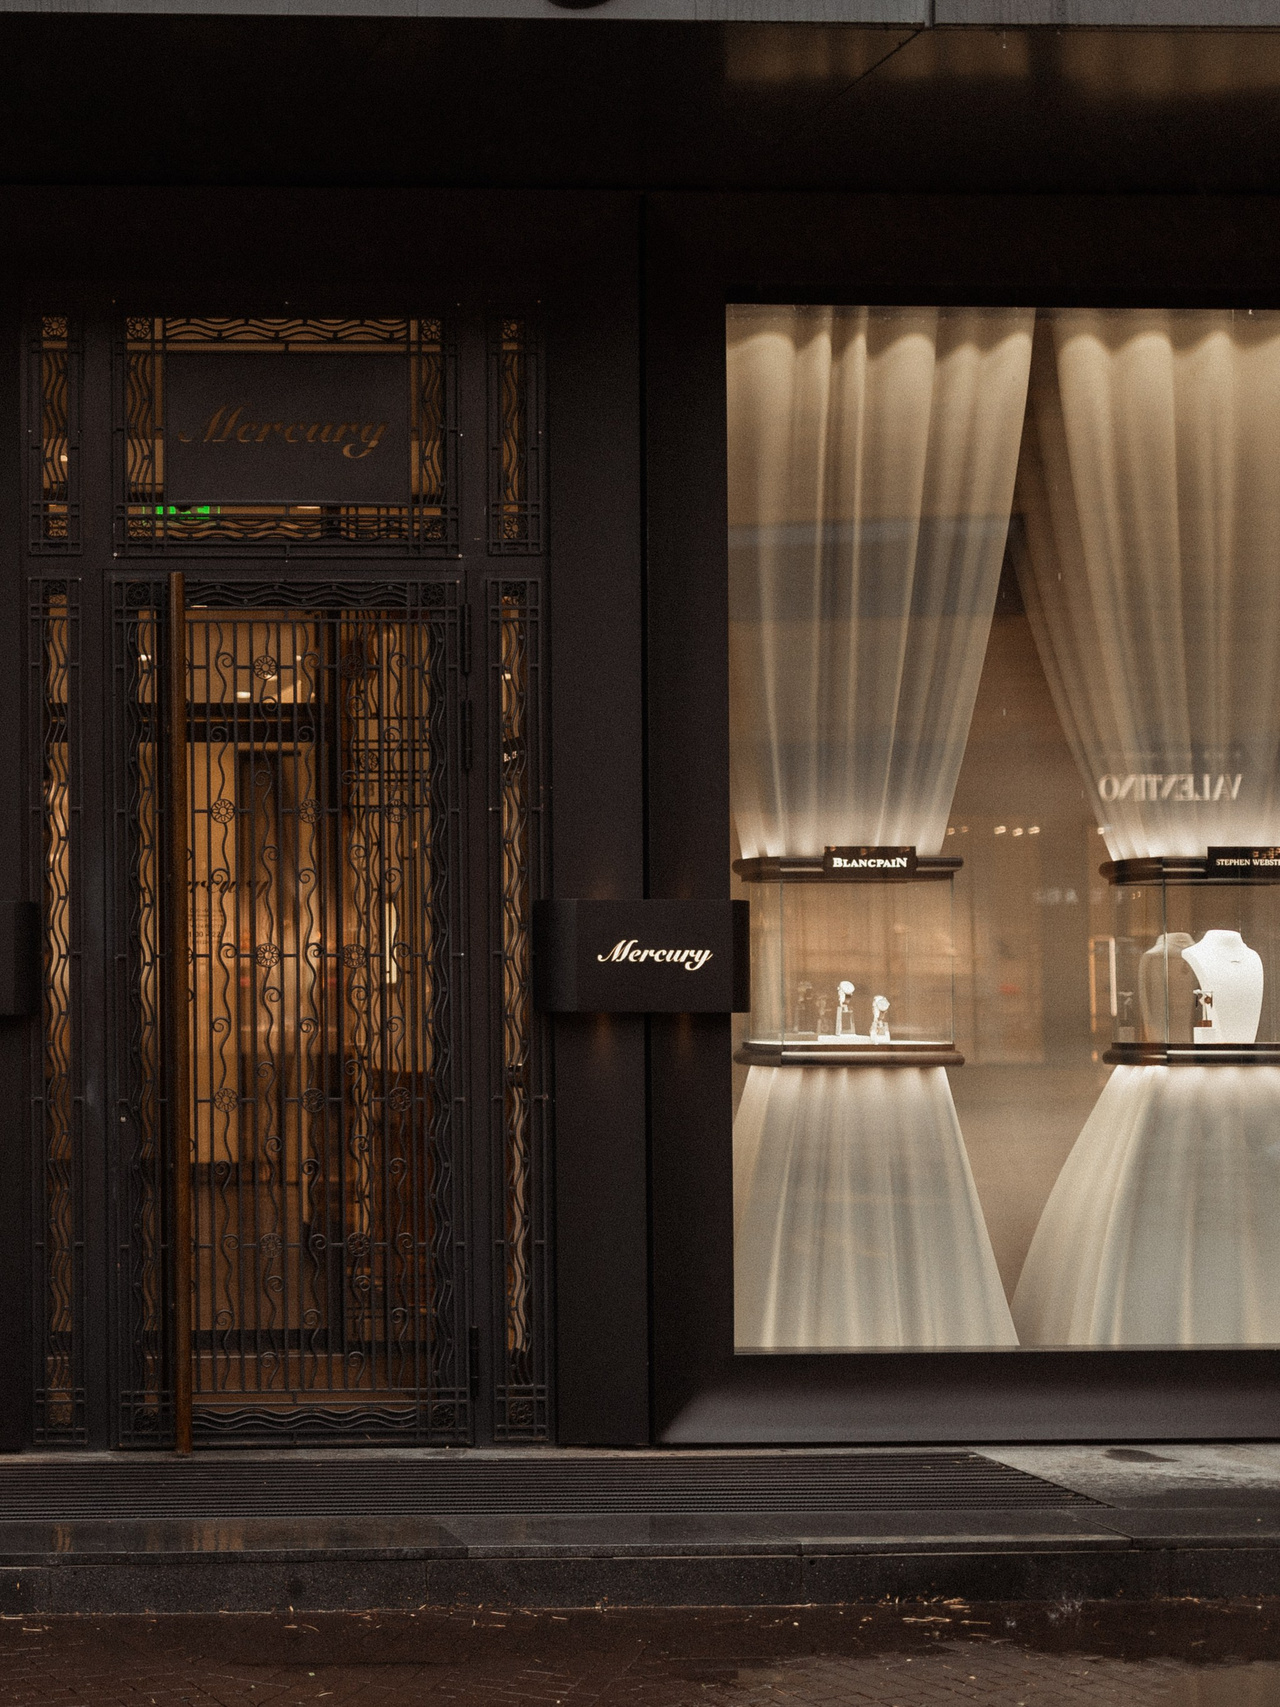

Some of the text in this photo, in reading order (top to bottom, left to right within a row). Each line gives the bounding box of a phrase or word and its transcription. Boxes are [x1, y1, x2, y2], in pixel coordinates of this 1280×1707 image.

[177, 402, 389, 459] Mercury
[832, 857, 908, 868] BLANCPAIN
[1216, 858, 1250, 866] STEPHEN
[597, 939, 714, 971] Mercury
